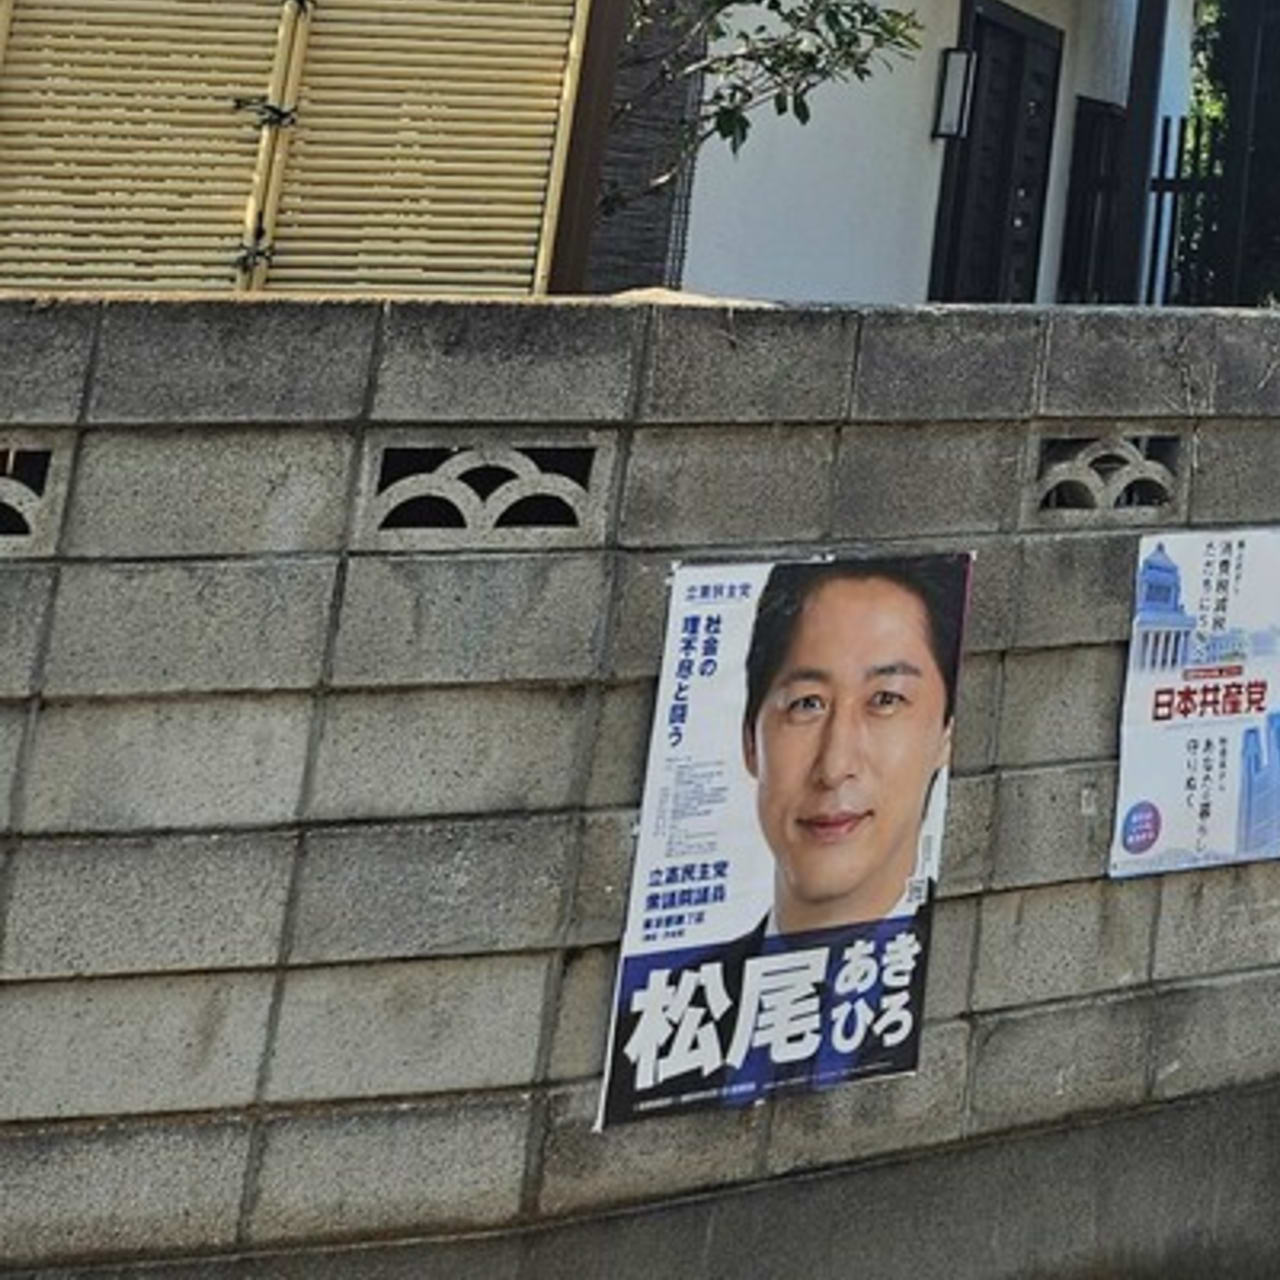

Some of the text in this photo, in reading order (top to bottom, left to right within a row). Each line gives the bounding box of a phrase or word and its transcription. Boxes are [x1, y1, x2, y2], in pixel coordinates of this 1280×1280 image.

[699, 613, 722, 678] 社会の
[1153, 680, 1268, 721] 日本共産党
[647, 859, 730, 887] 立憲民主党
[834, 931, 922, 994] あき
[623, 946, 830, 1091] 松尾
[830, 991, 919, 1054] ひろ
